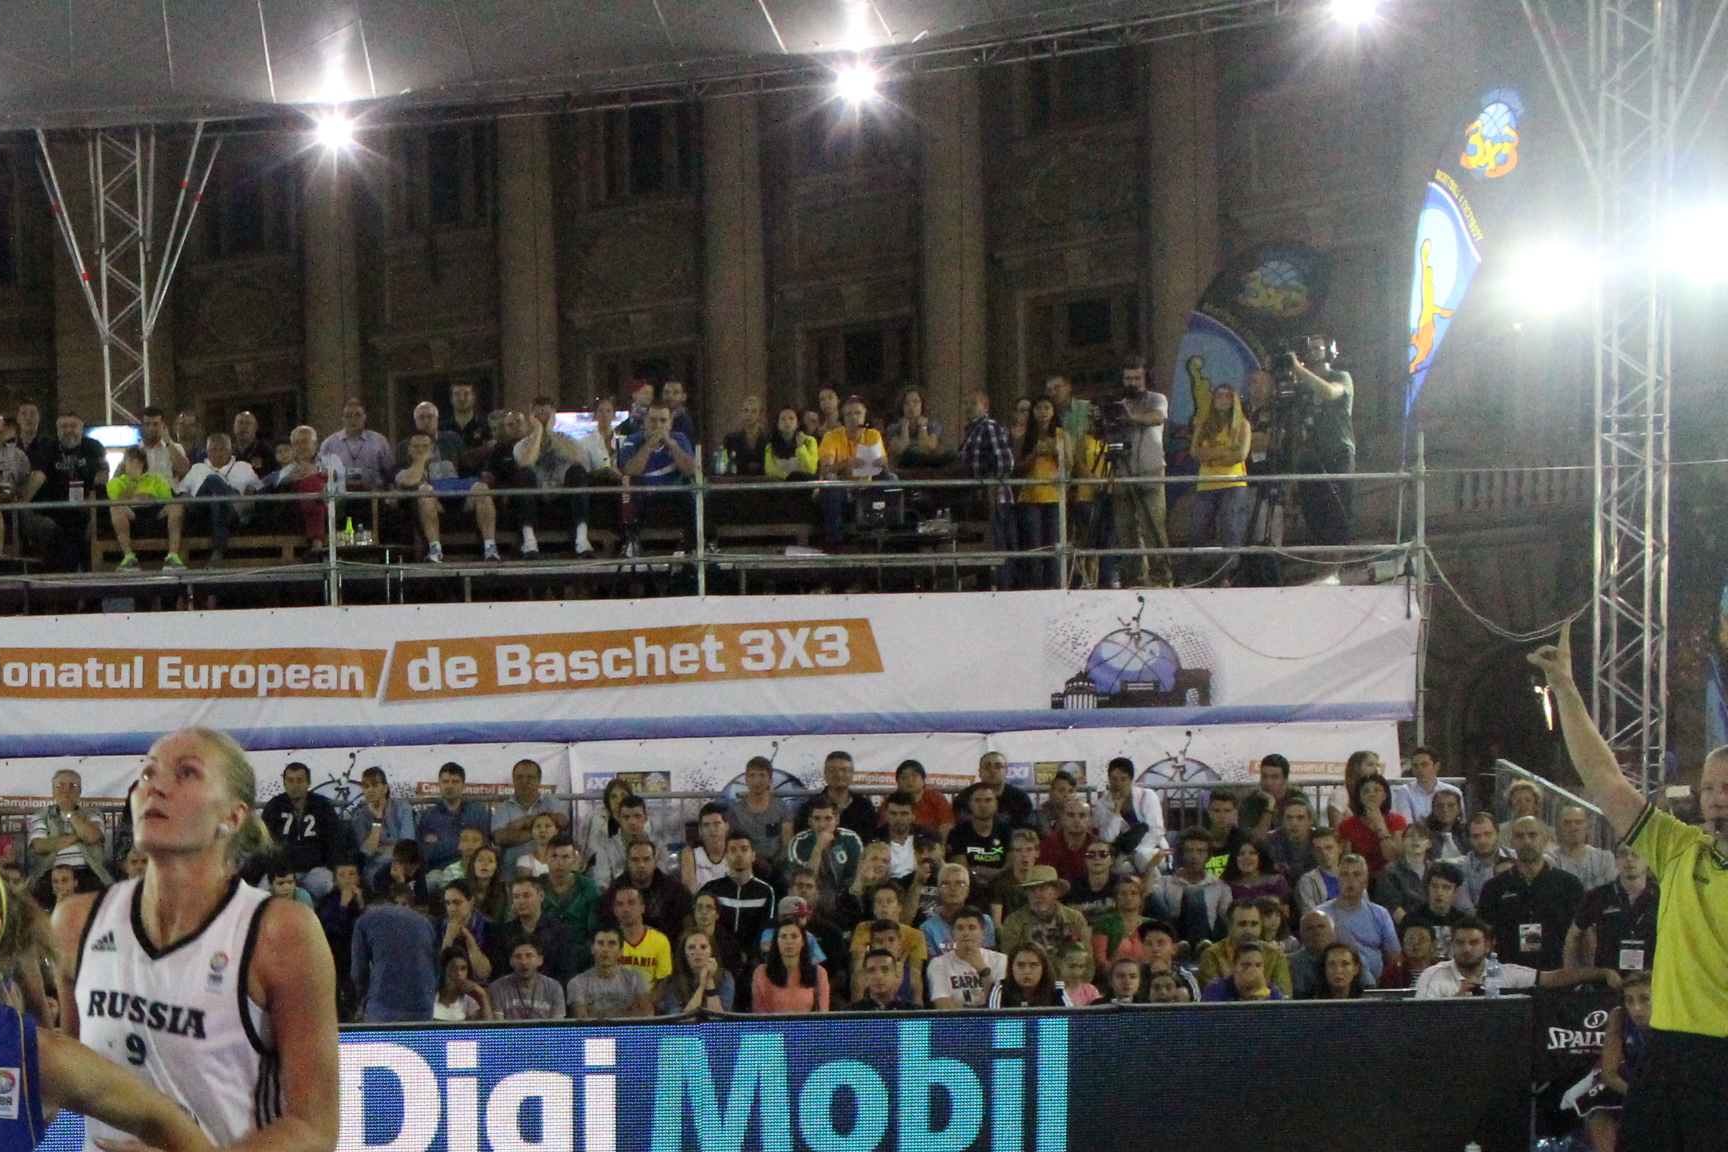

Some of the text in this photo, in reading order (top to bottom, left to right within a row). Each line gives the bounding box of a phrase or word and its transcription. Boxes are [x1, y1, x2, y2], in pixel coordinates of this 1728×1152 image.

[158, 656, 364, 696] European
[408, 647, 477, 692] de
[496, 634, 725, 687] Baschet
[739, 625, 850, 672] 3X3
[618, 955, 658, 967] OMANIA
[88, 989, 207, 1039] RUSSIA
[126, 1033, 147, 1066] 9
